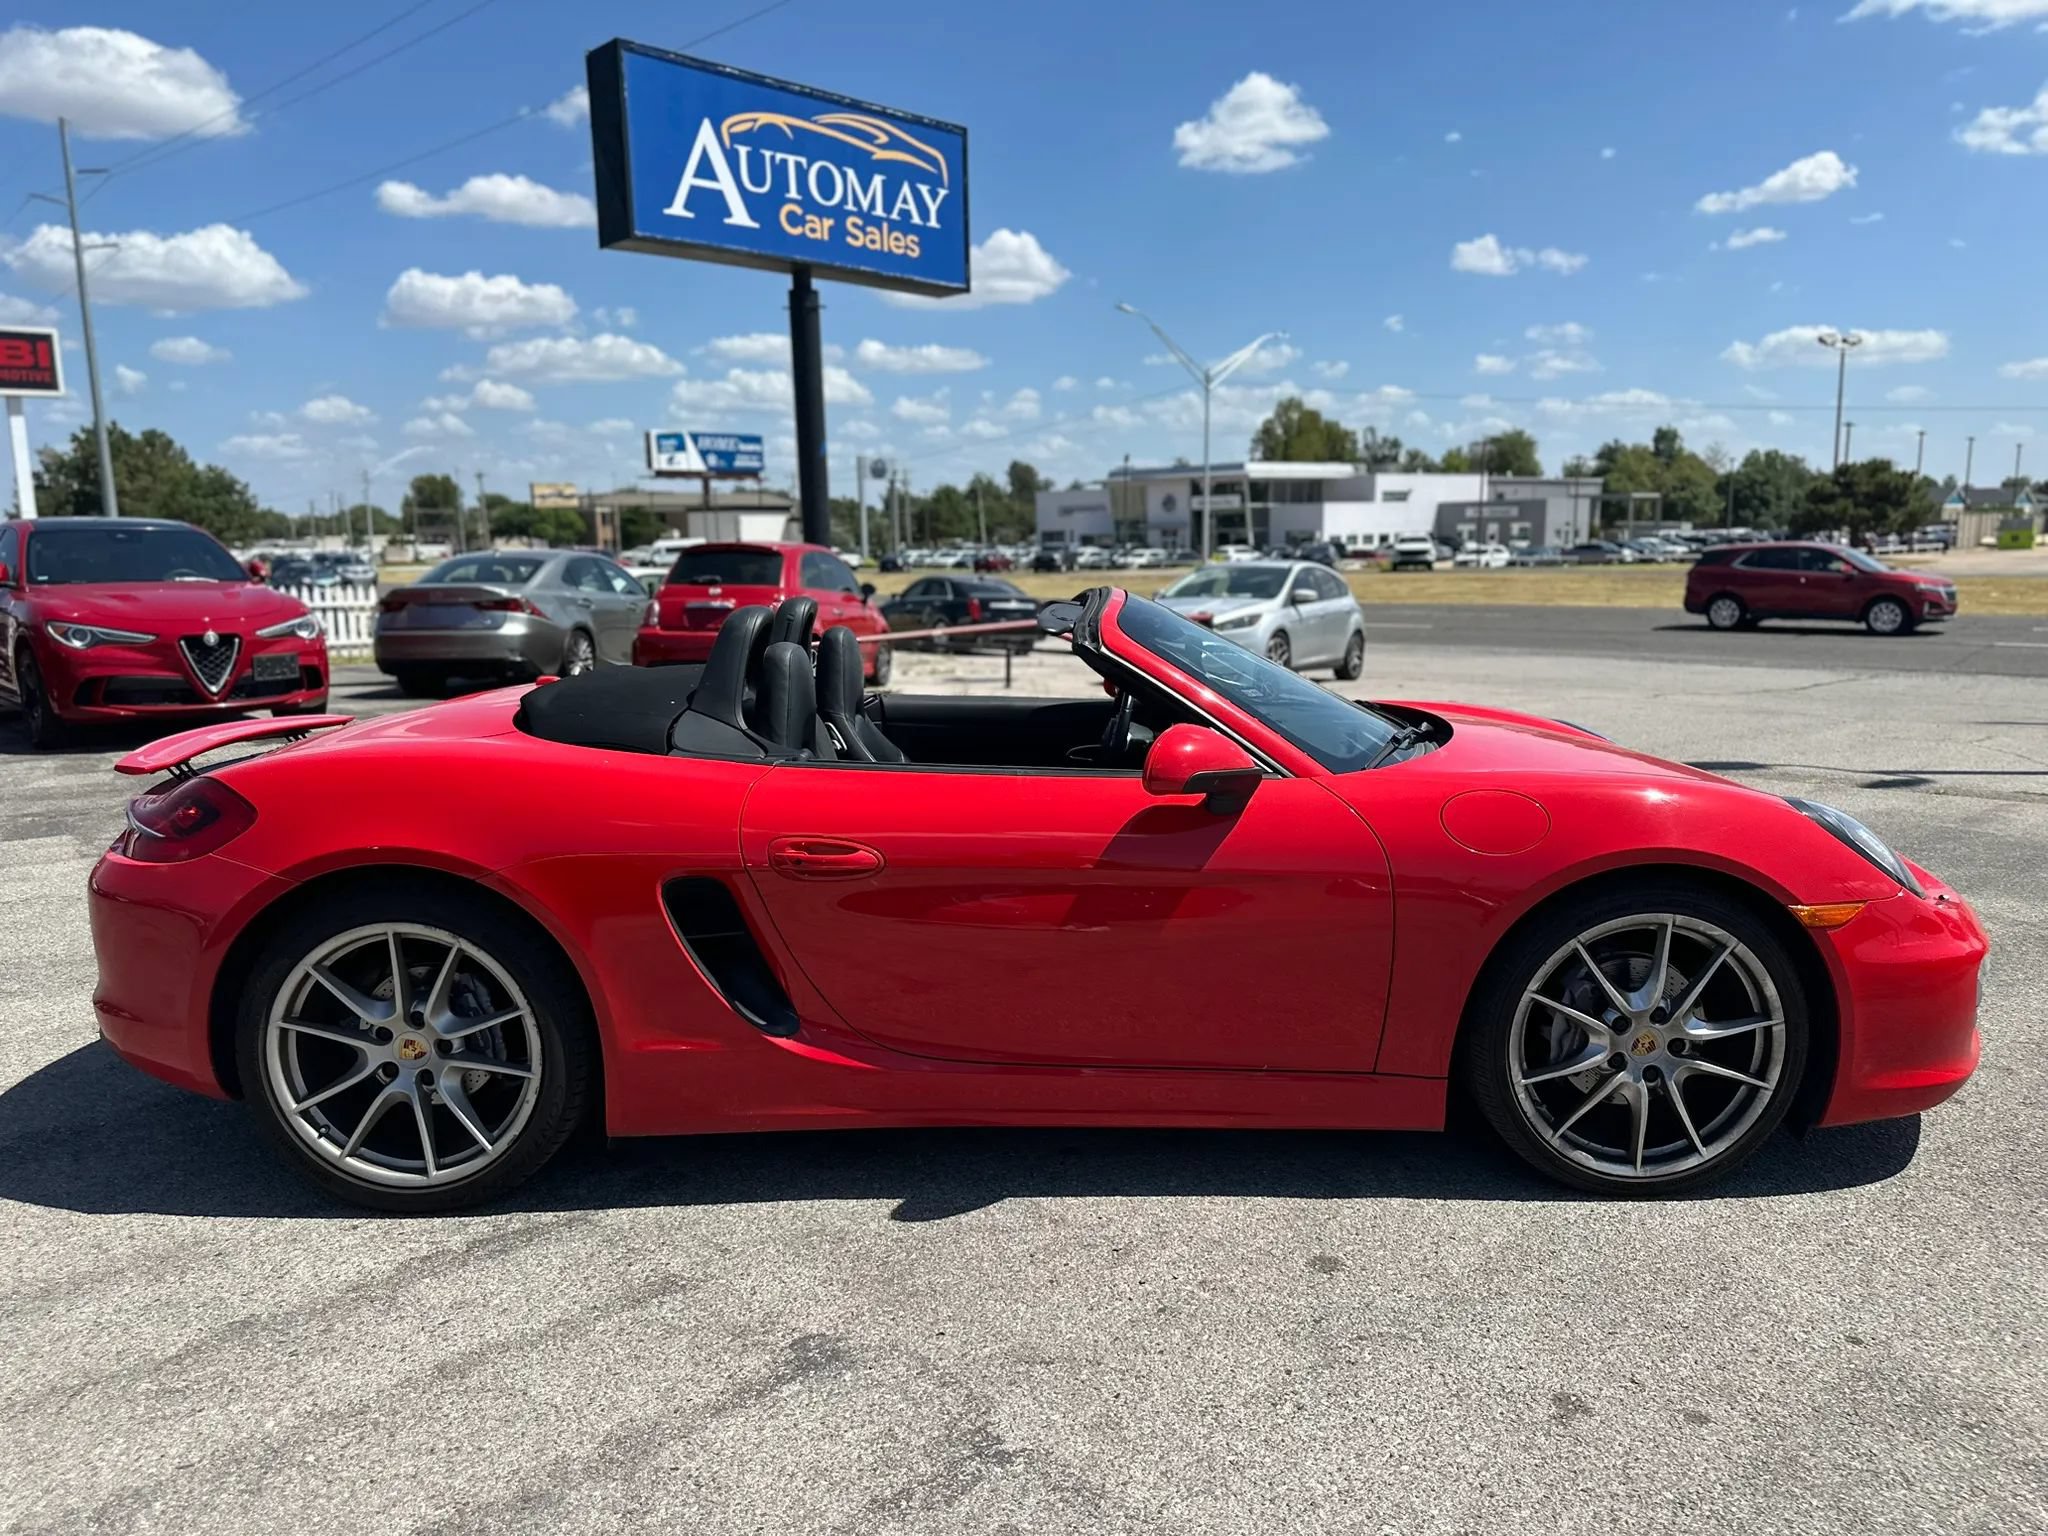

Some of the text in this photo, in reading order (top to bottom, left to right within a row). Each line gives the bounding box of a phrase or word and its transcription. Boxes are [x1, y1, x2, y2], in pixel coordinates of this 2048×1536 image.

[662, 117, 949, 229] AUTOMAY
[779, 203, 921, 259] Car Sales
